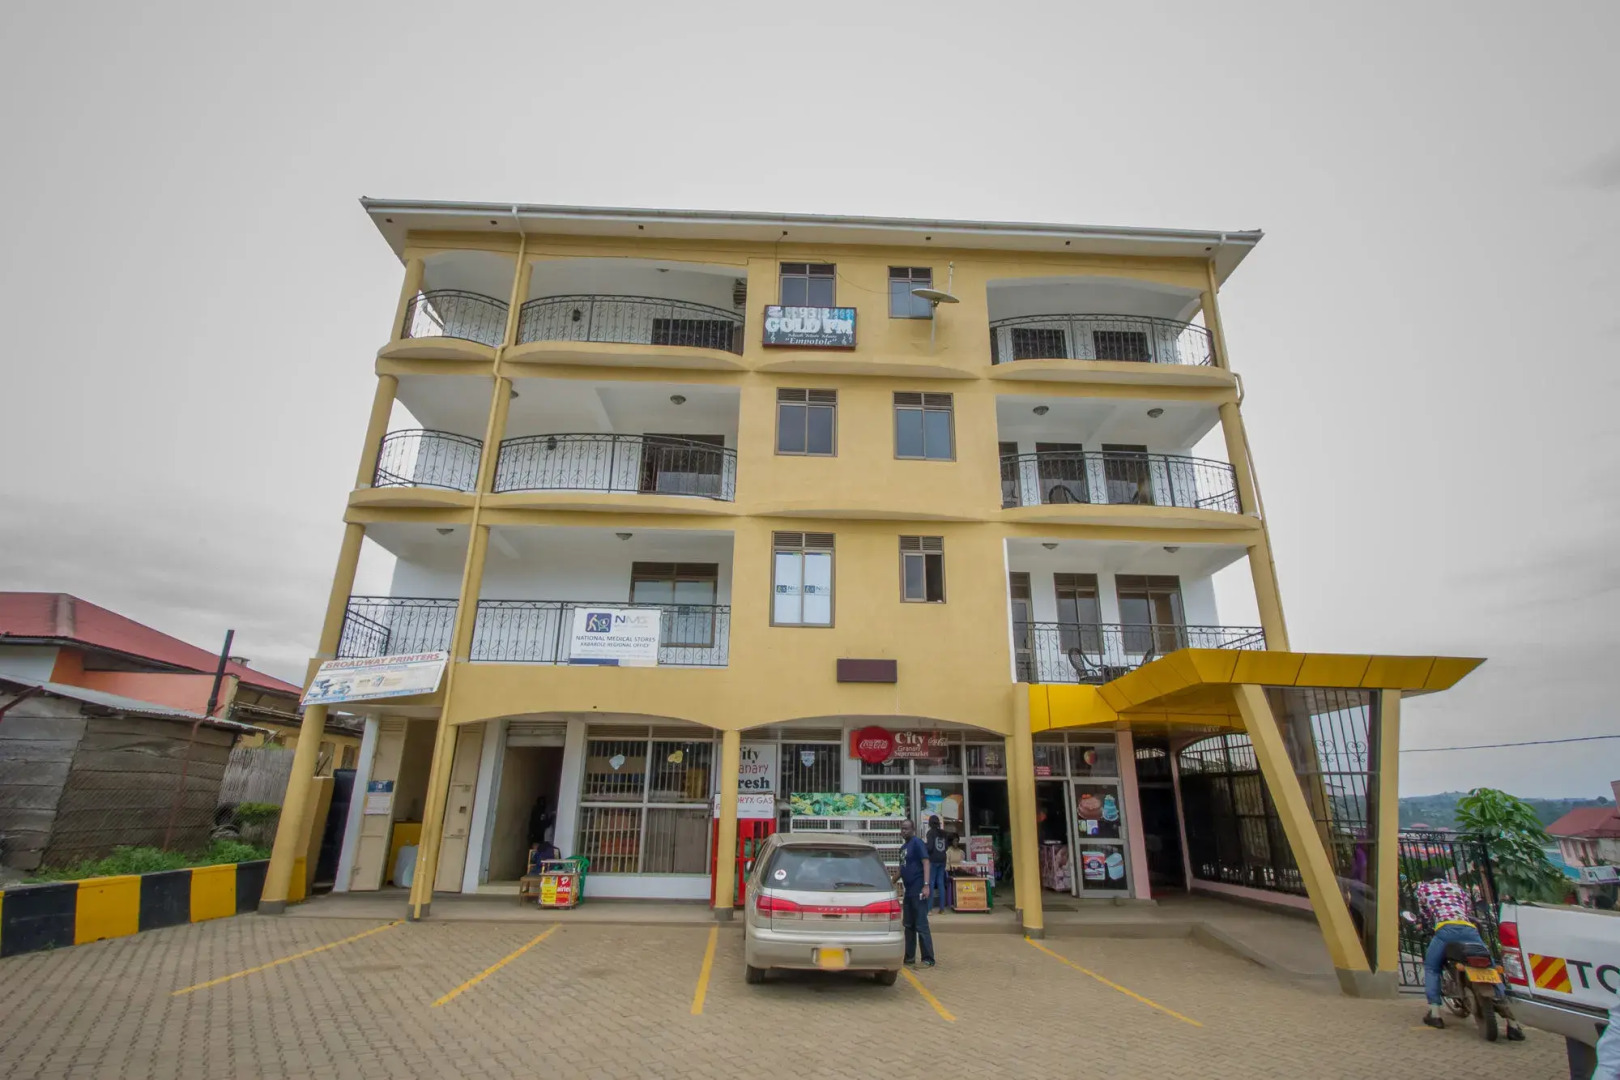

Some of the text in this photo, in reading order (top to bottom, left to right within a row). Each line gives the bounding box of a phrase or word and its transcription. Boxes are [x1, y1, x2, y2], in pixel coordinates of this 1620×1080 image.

[765, 317, 853, 334] GOLD FM
[325, 657, 387, 668] BROADWAY
[388, 653, 440, 663] PRINTERS
[894, 731, 925, 747] City
[740, 746, 760, 764] ity
[739, 763, 769, 775] anary
[737, 776, 770, 789] resh
[756, 796, 773, 804] GAS
